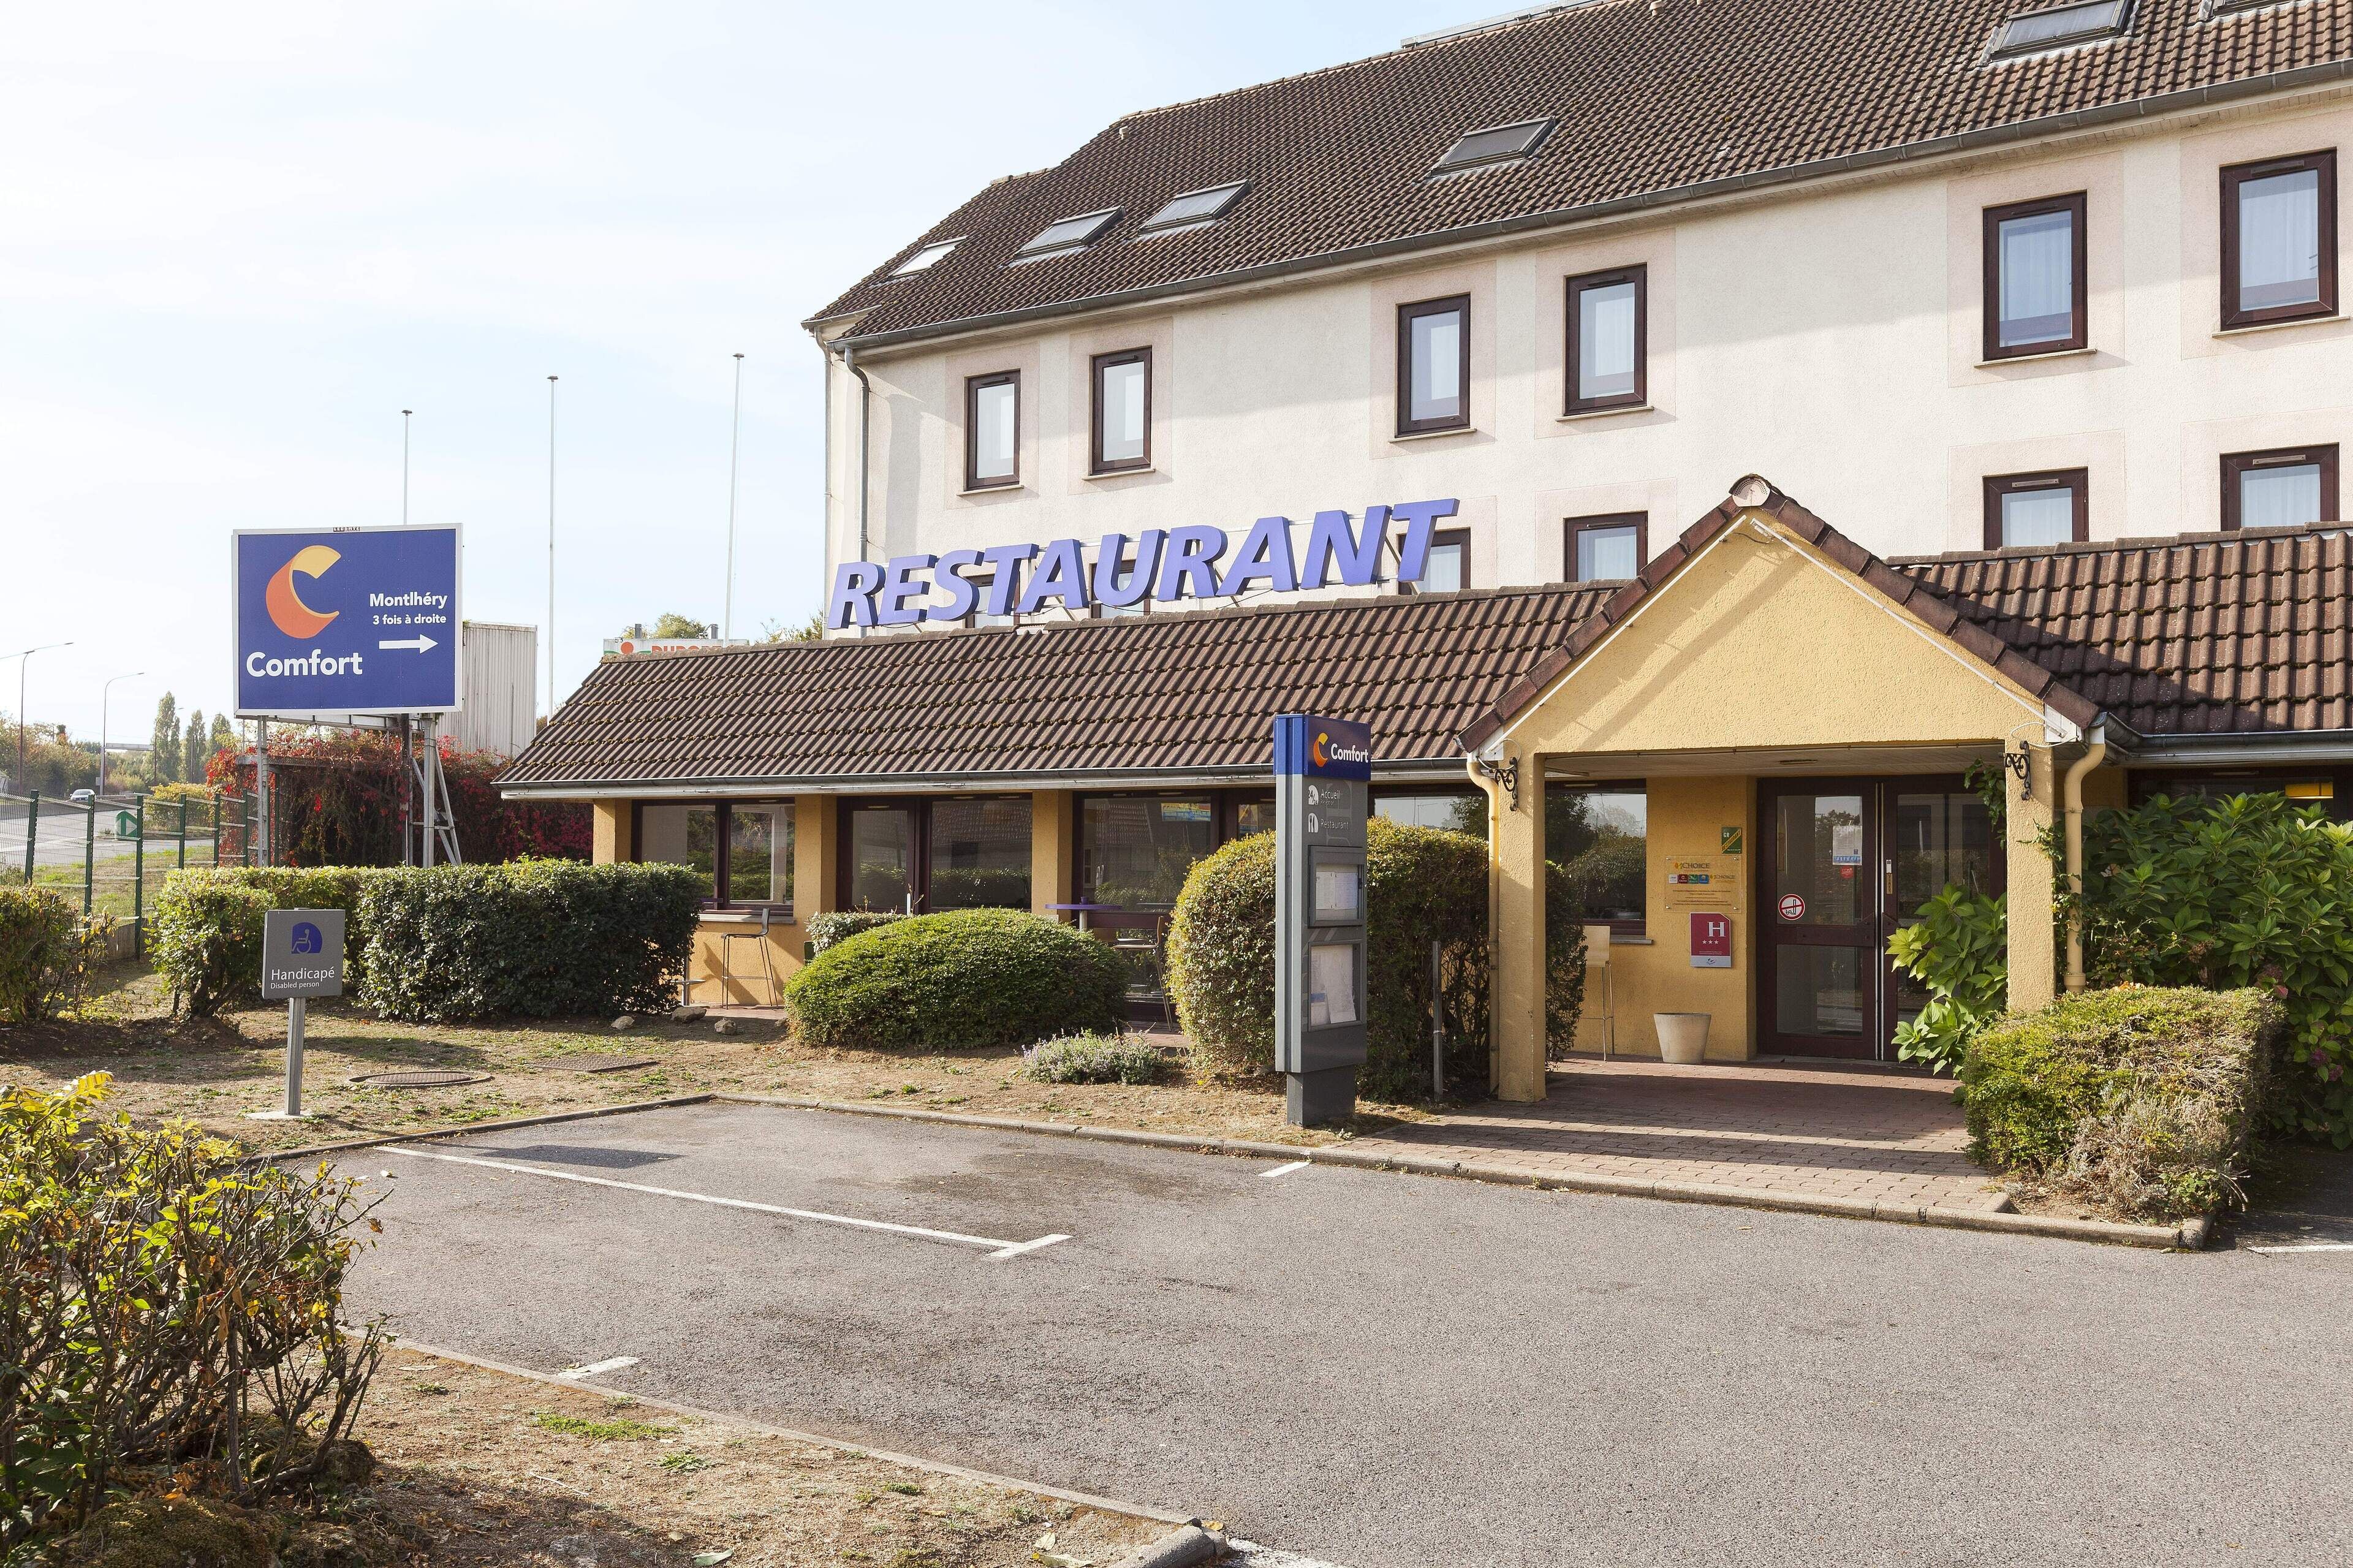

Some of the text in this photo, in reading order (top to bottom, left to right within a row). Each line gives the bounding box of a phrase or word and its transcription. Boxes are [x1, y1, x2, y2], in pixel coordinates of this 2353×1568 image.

[828, 498, 1460, 629] RESTAURANT
[369, 592, 447, 608] Montlhéry
[373, 613, 447, 624] 3 fois à droite
[246, 648, 363, 677] Comfort
[1330, 743, 1369, 763] Comfort
[1320, 789, 1340, 799] Accueil
[1321, 818, 1349, 829] Restaurant
[1707, 922, 1726, 937] H
[271, 966, 335, 982] Handicapé
